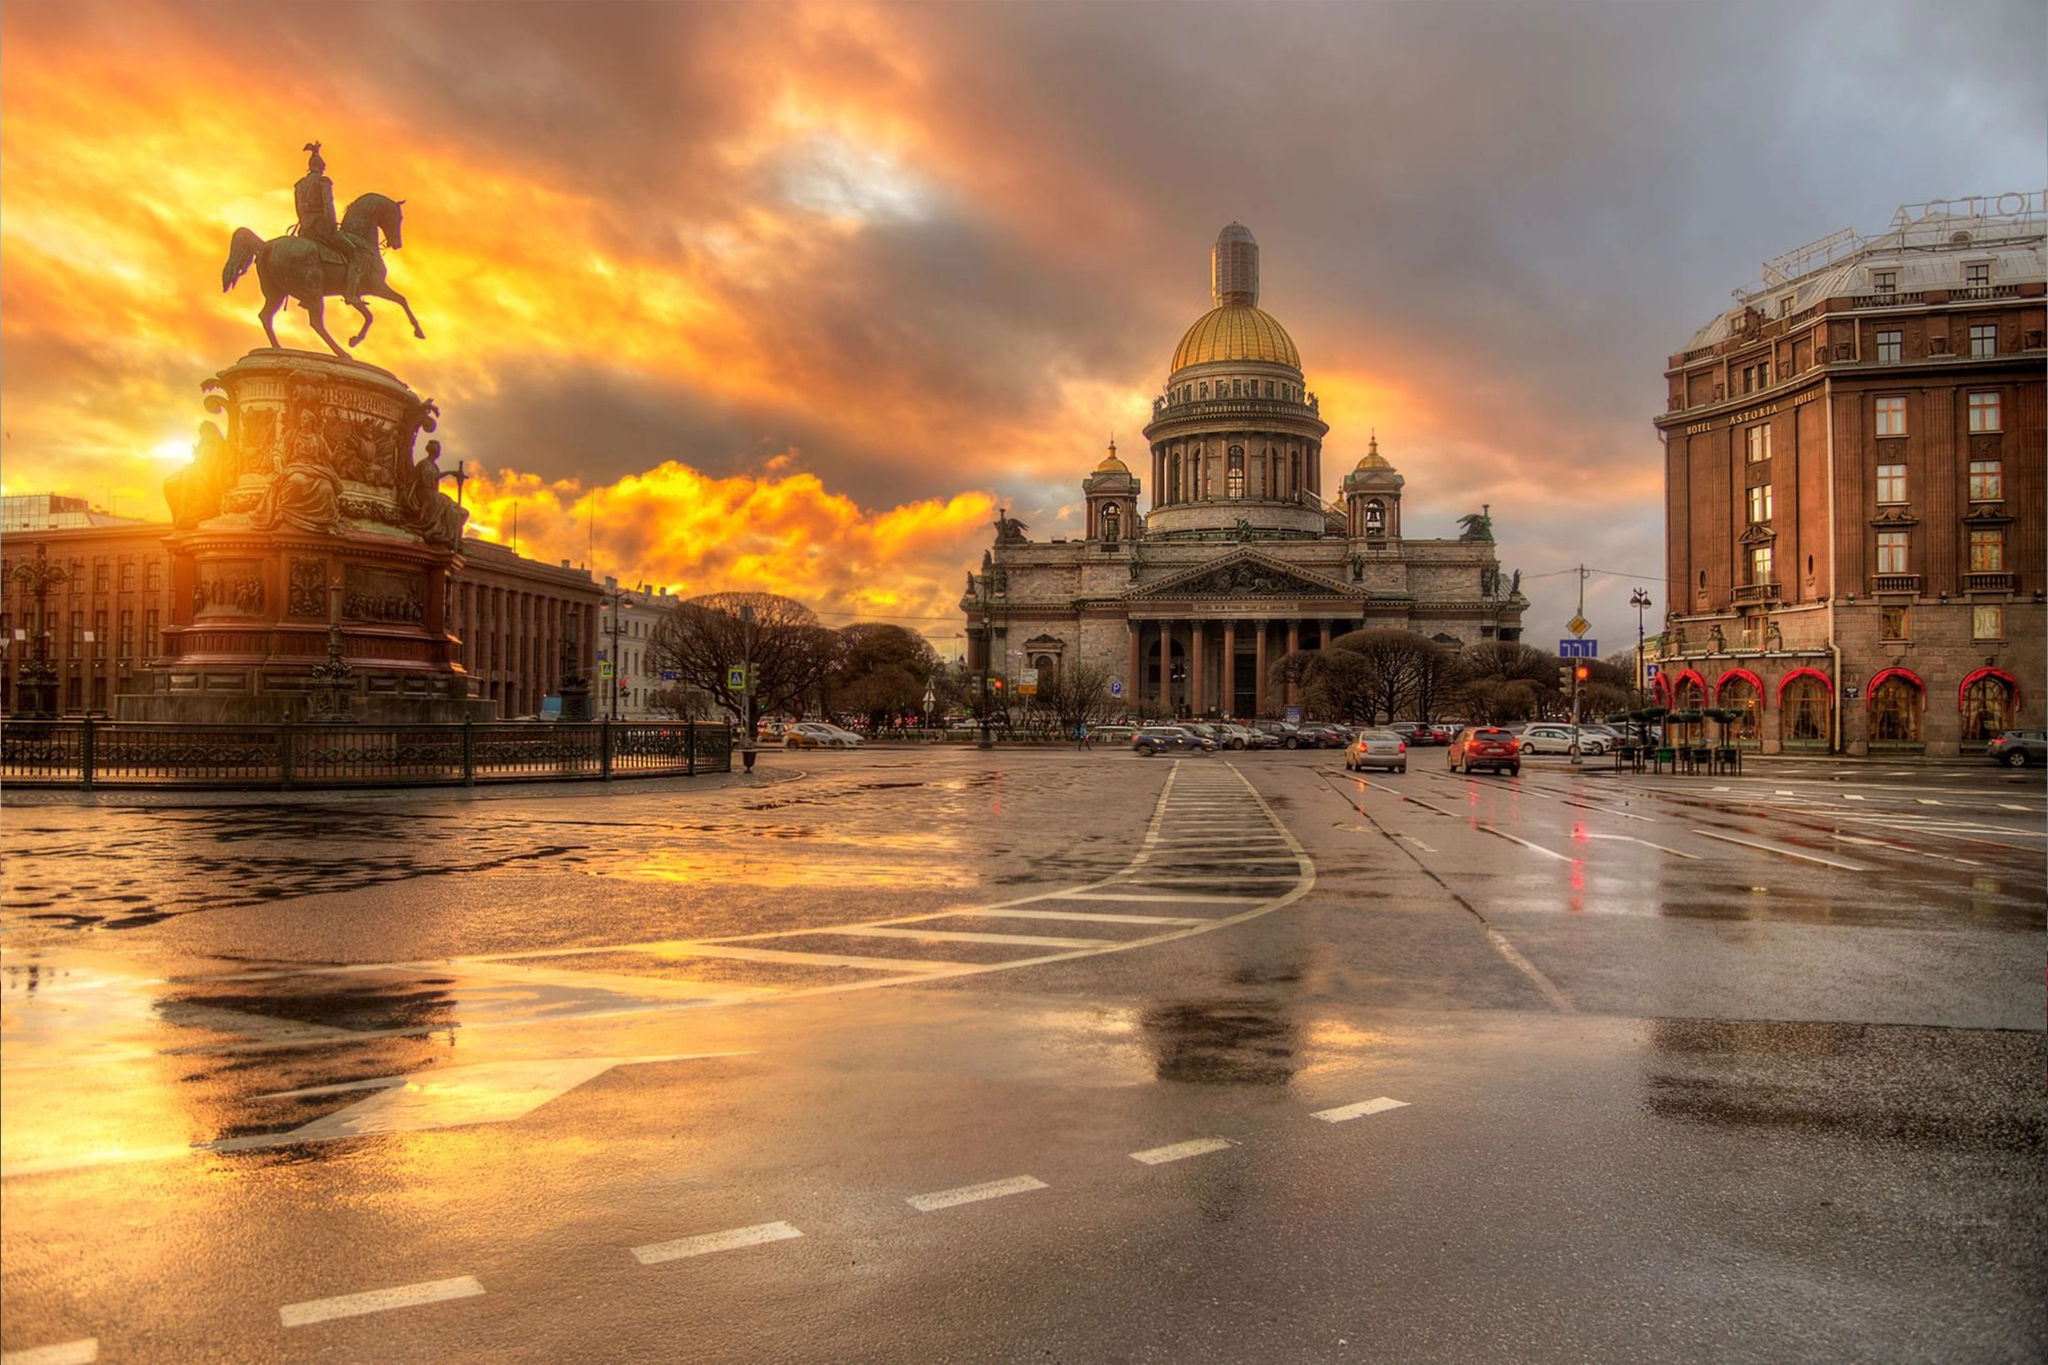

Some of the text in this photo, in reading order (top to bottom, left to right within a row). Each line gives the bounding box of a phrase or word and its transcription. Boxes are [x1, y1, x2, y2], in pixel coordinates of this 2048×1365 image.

[1686, 422, 1712, 435] HOTEL
[1729, 404, 1778, 425] ASTORIA
[1113, 683, 1120, 693] P
